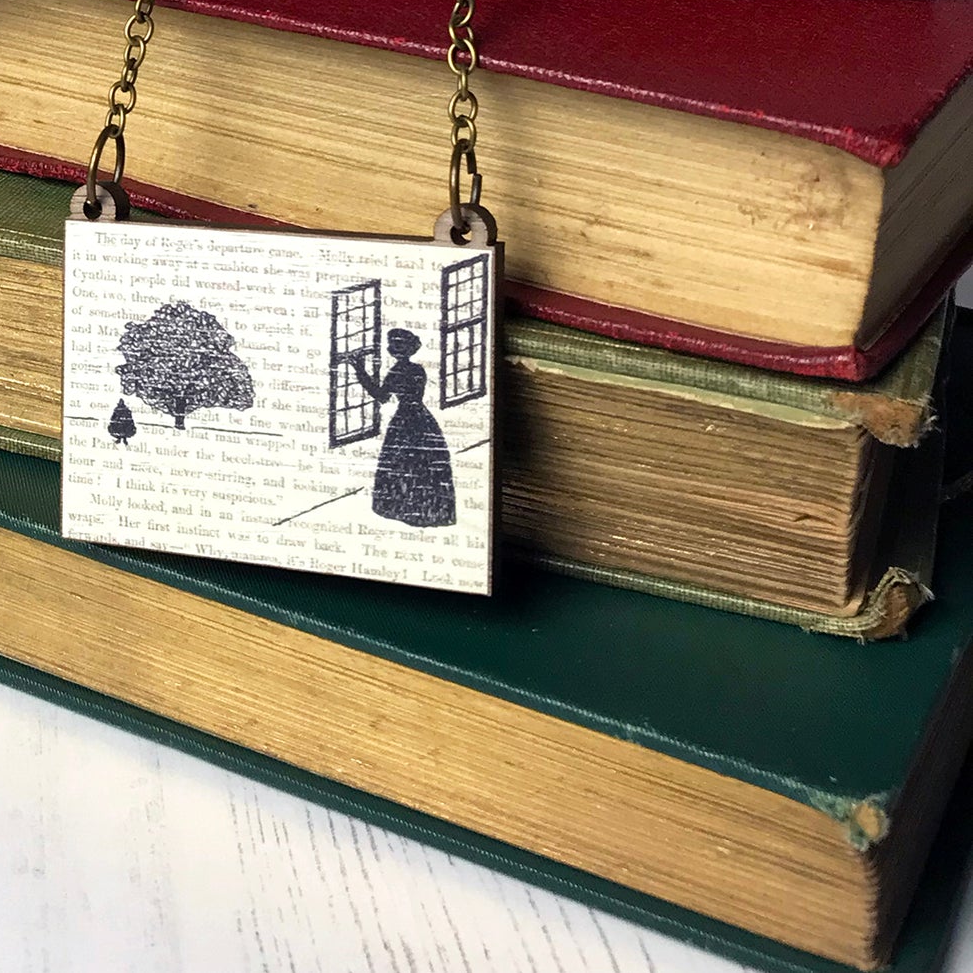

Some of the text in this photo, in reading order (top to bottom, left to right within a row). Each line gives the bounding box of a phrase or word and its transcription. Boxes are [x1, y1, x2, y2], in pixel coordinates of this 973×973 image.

[102, 252, 148, 268] working
[171, 274, 189, 287] did
[126, 477, 155, 492] think
[172, 502, 192, 515] and
[200, 505, 211, 517] in
[147, 518, 169, 532] first
